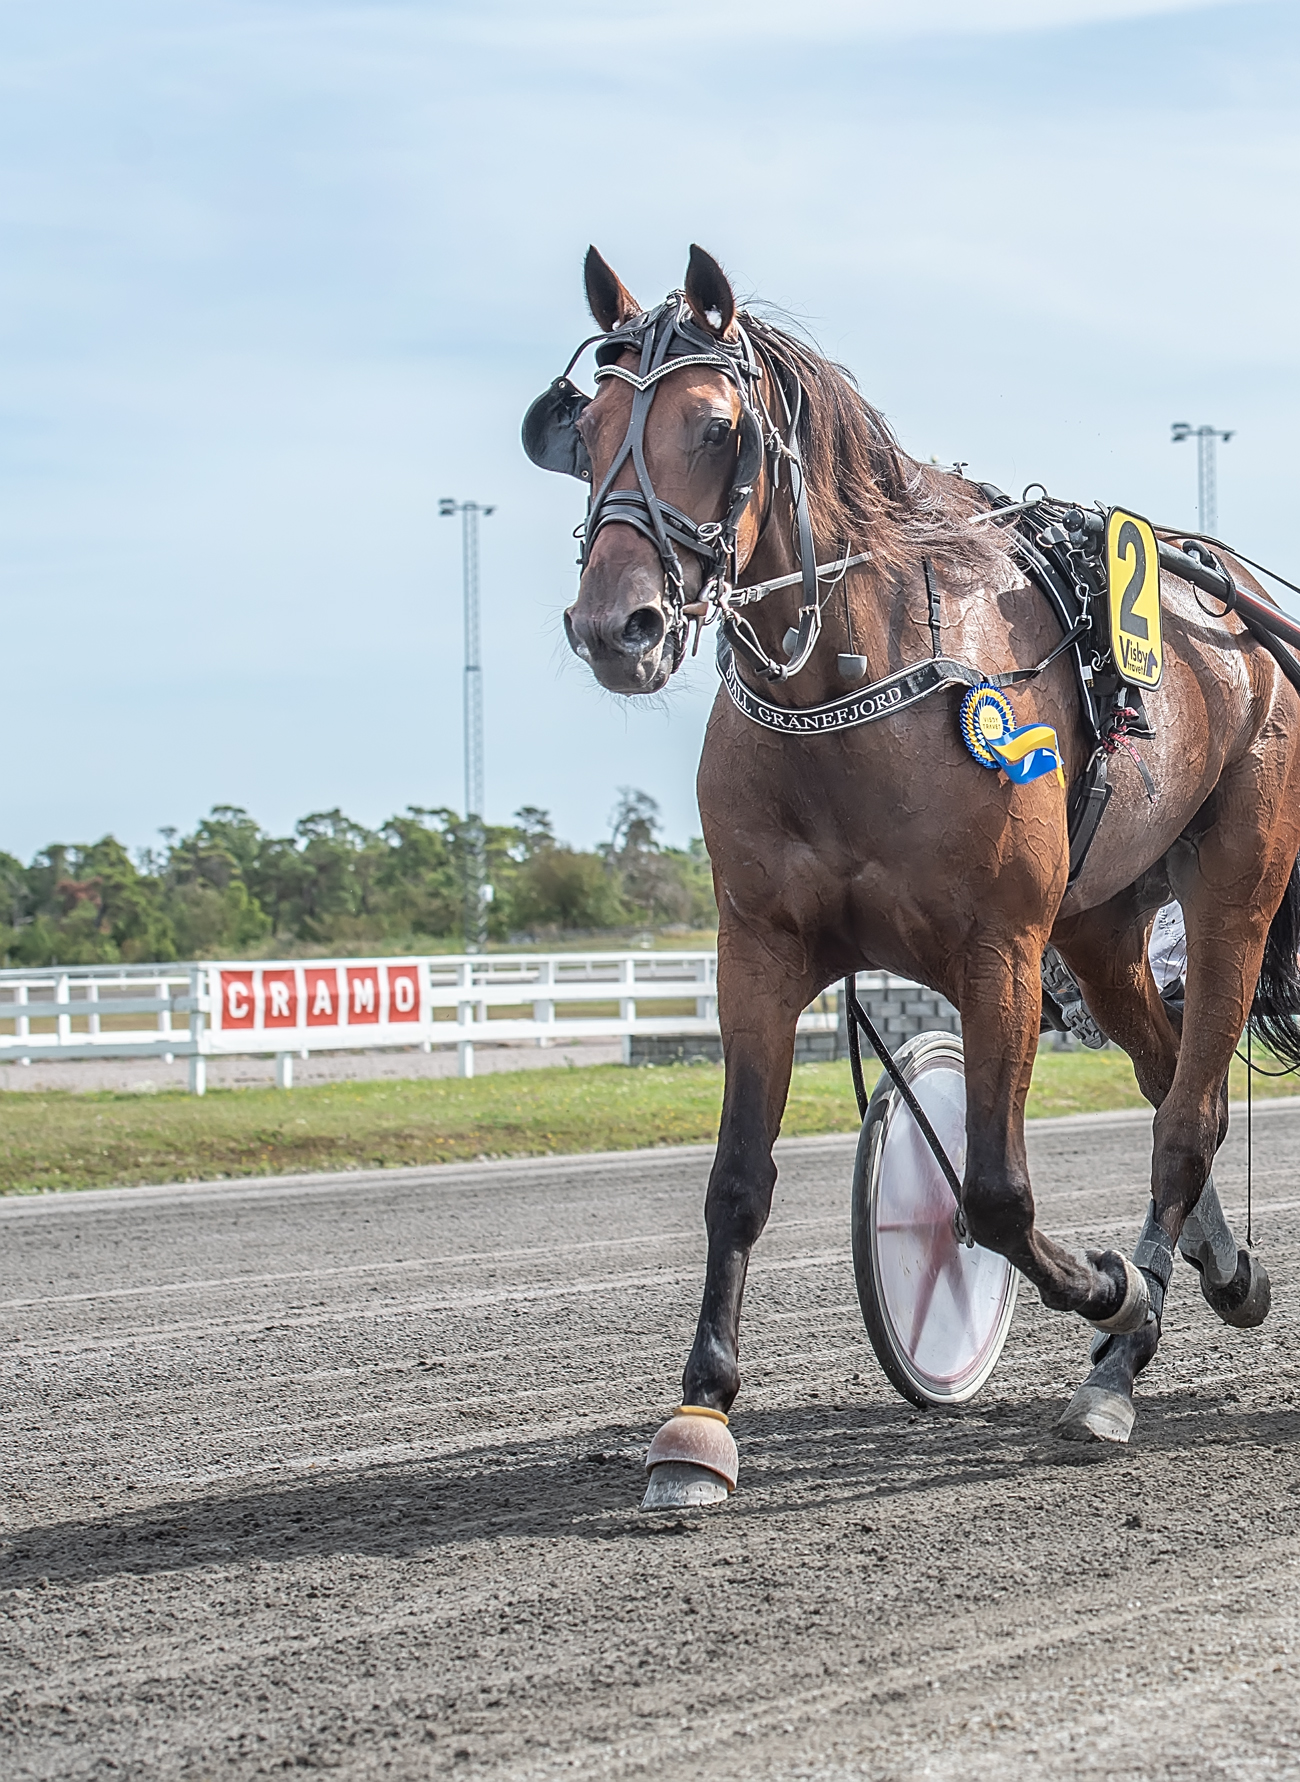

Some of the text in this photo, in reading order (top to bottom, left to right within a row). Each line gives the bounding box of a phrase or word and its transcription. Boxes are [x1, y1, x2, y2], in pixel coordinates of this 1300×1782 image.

[1117, 520, 1149, 641] 2
[1119, 635, 1148, 676] Visby
[758, 687, 903, 730] GRÄNEFJORD
[227, 976, 415, 1018] CRAMO
